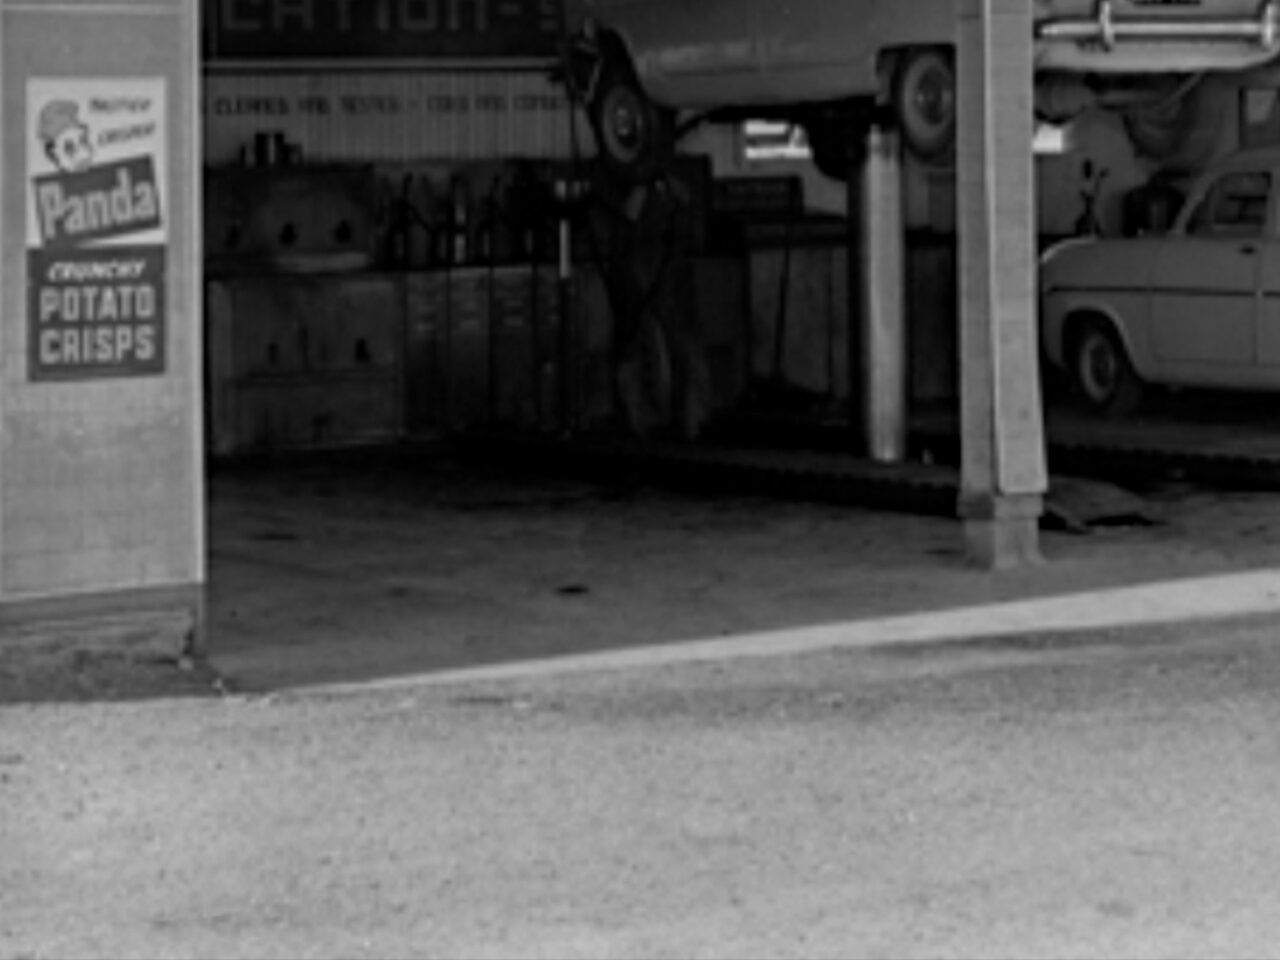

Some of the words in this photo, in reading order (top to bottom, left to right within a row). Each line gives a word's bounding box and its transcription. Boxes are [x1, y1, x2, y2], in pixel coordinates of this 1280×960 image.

[37, 167, 157, 241] Panda
[38, 285, 157, 324] POTATO
[38, 323, 157, 365] CRISPS
